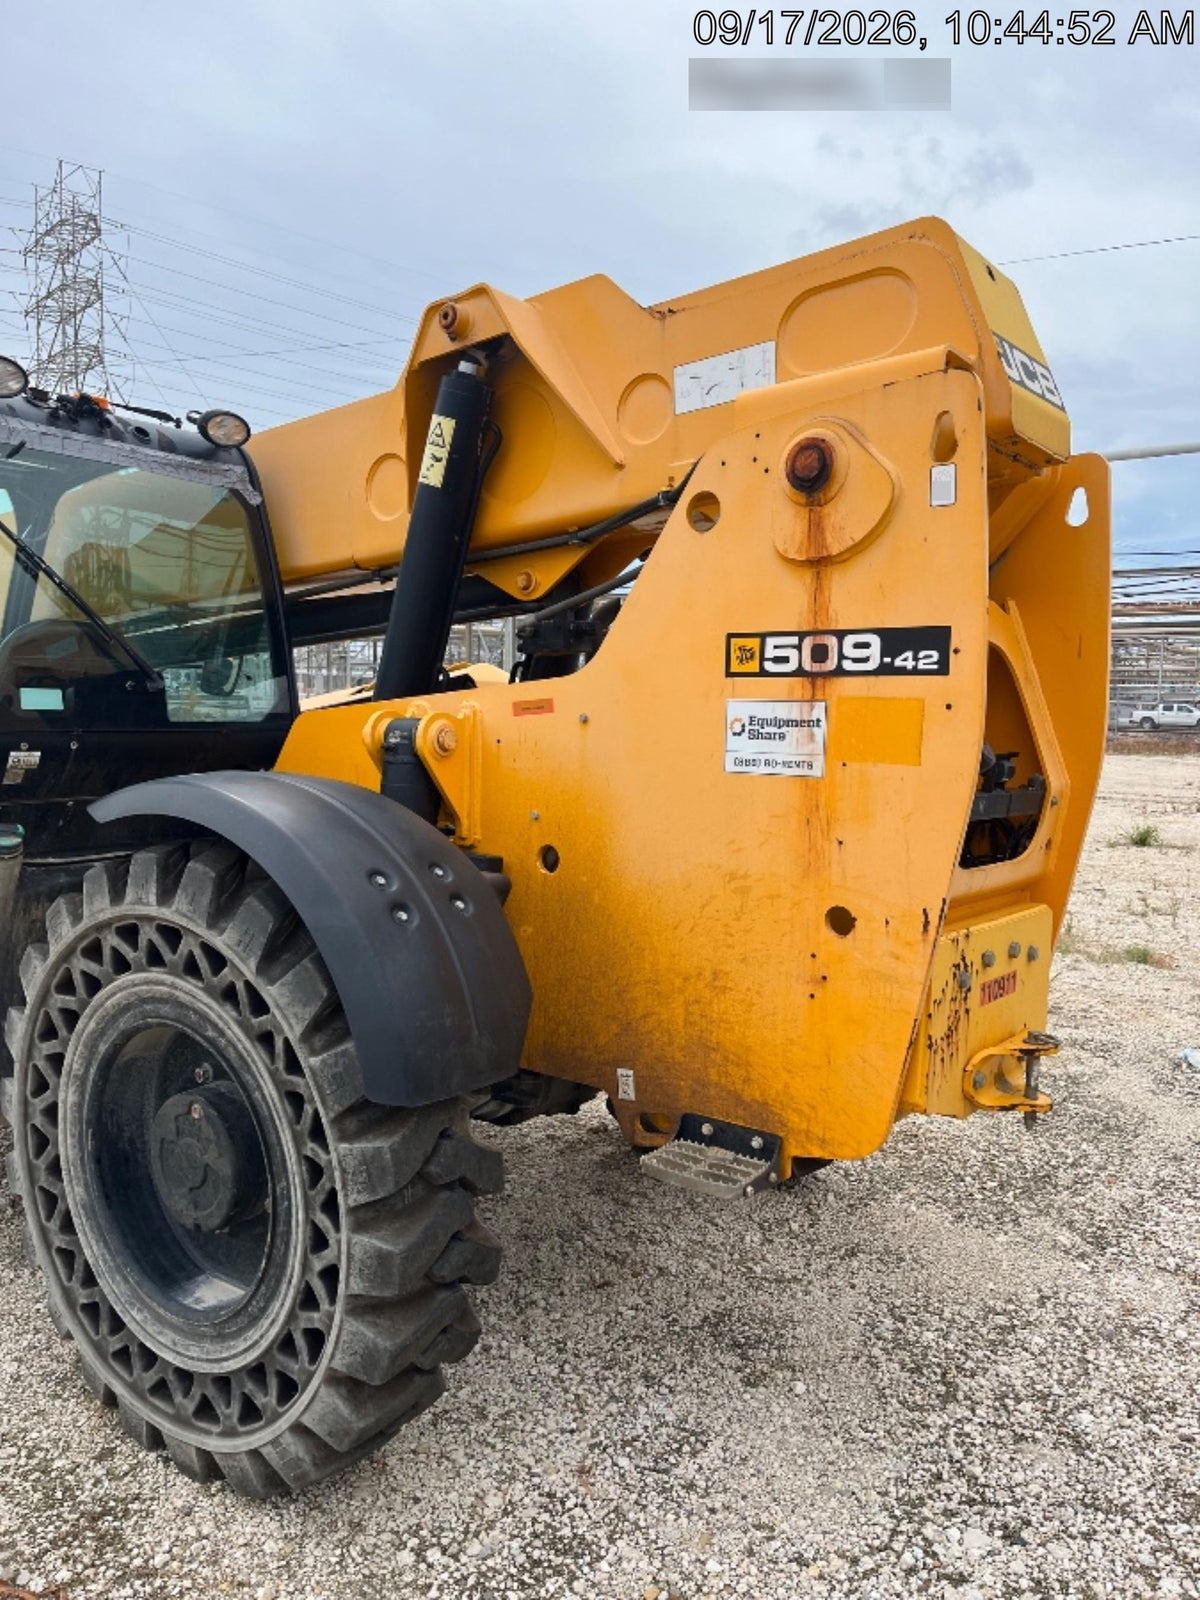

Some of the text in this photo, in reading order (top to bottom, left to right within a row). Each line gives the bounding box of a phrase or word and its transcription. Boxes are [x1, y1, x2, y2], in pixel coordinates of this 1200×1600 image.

[1000, 340, 1062, 407] JCB
[763, 633, 940, 673] 509-42
[748, 716, 822, 729] Equipment
[748, 729, 786, 741] Share
[980, 970, 1017, 1006] 110911
